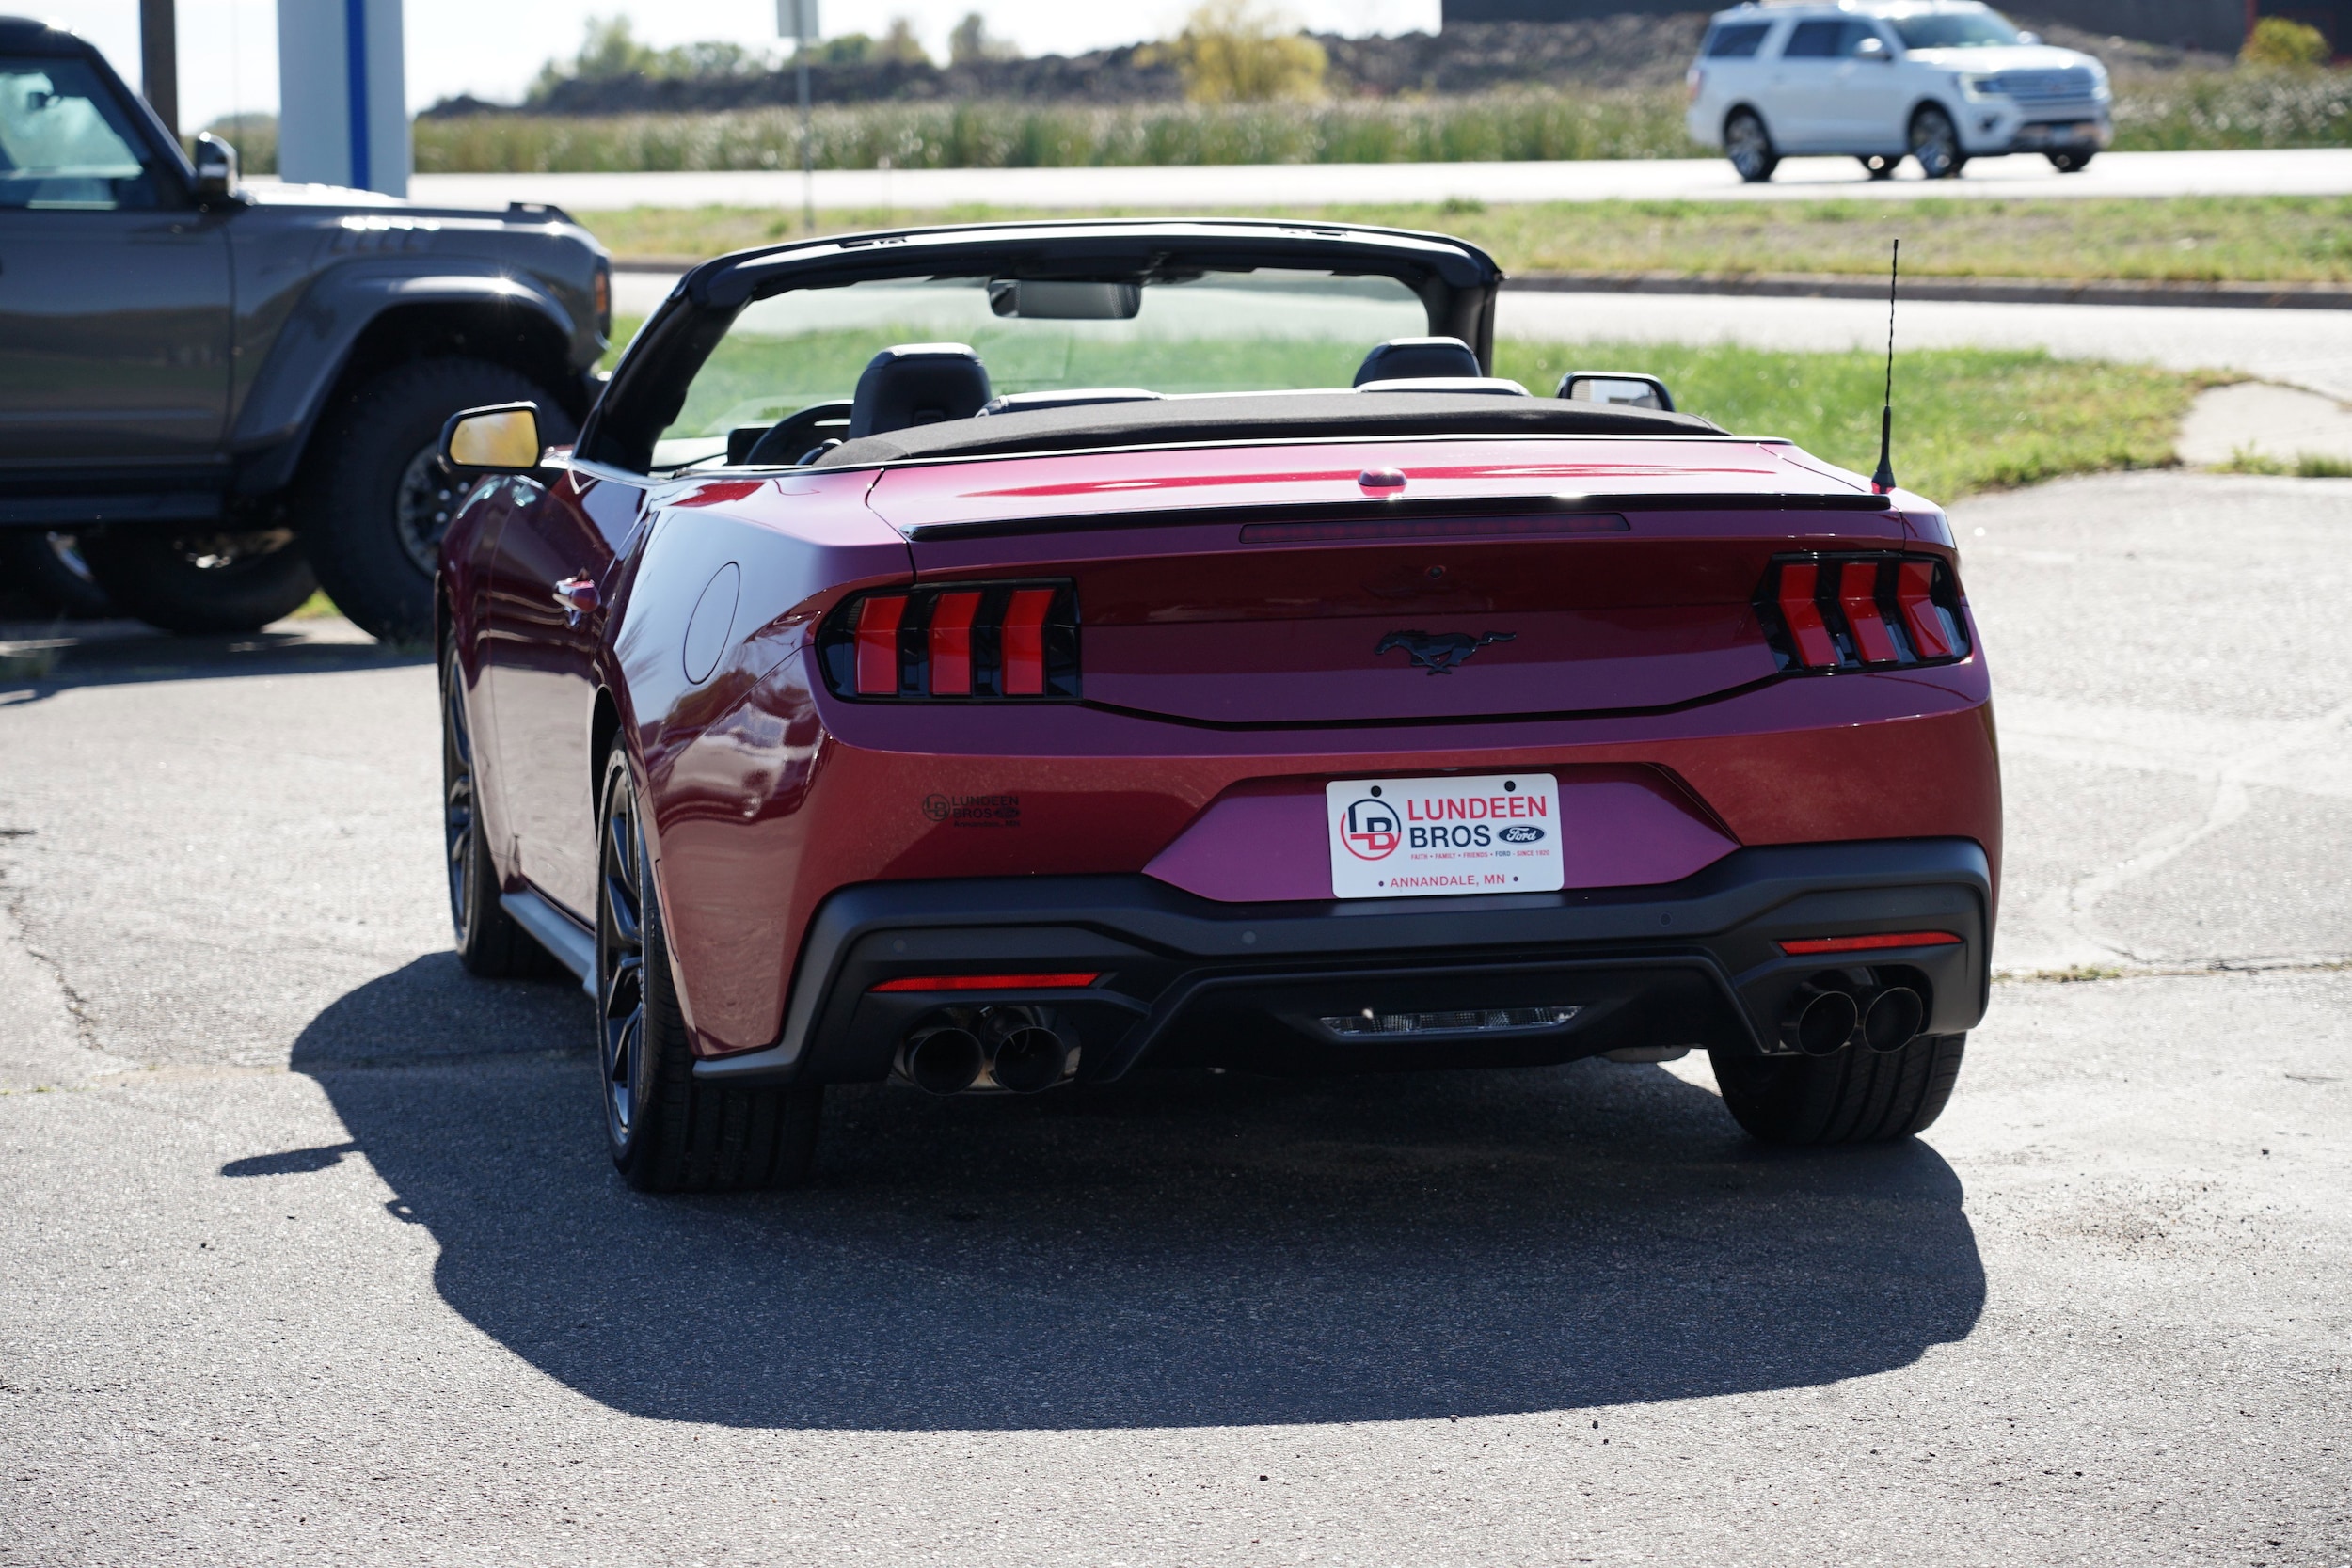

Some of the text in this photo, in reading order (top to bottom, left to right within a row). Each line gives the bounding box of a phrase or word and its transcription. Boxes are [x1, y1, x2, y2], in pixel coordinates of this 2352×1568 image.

[952, 796, 1019, 806] LUNDEEN
[953, 808, 993, 818] BROS
[1407, 796, 1548, 821] LUNDEEN
[1409, 824, 1537, 848] BROS Ford
[1391, 874, 1505, 888] ANNANDALE, MN
